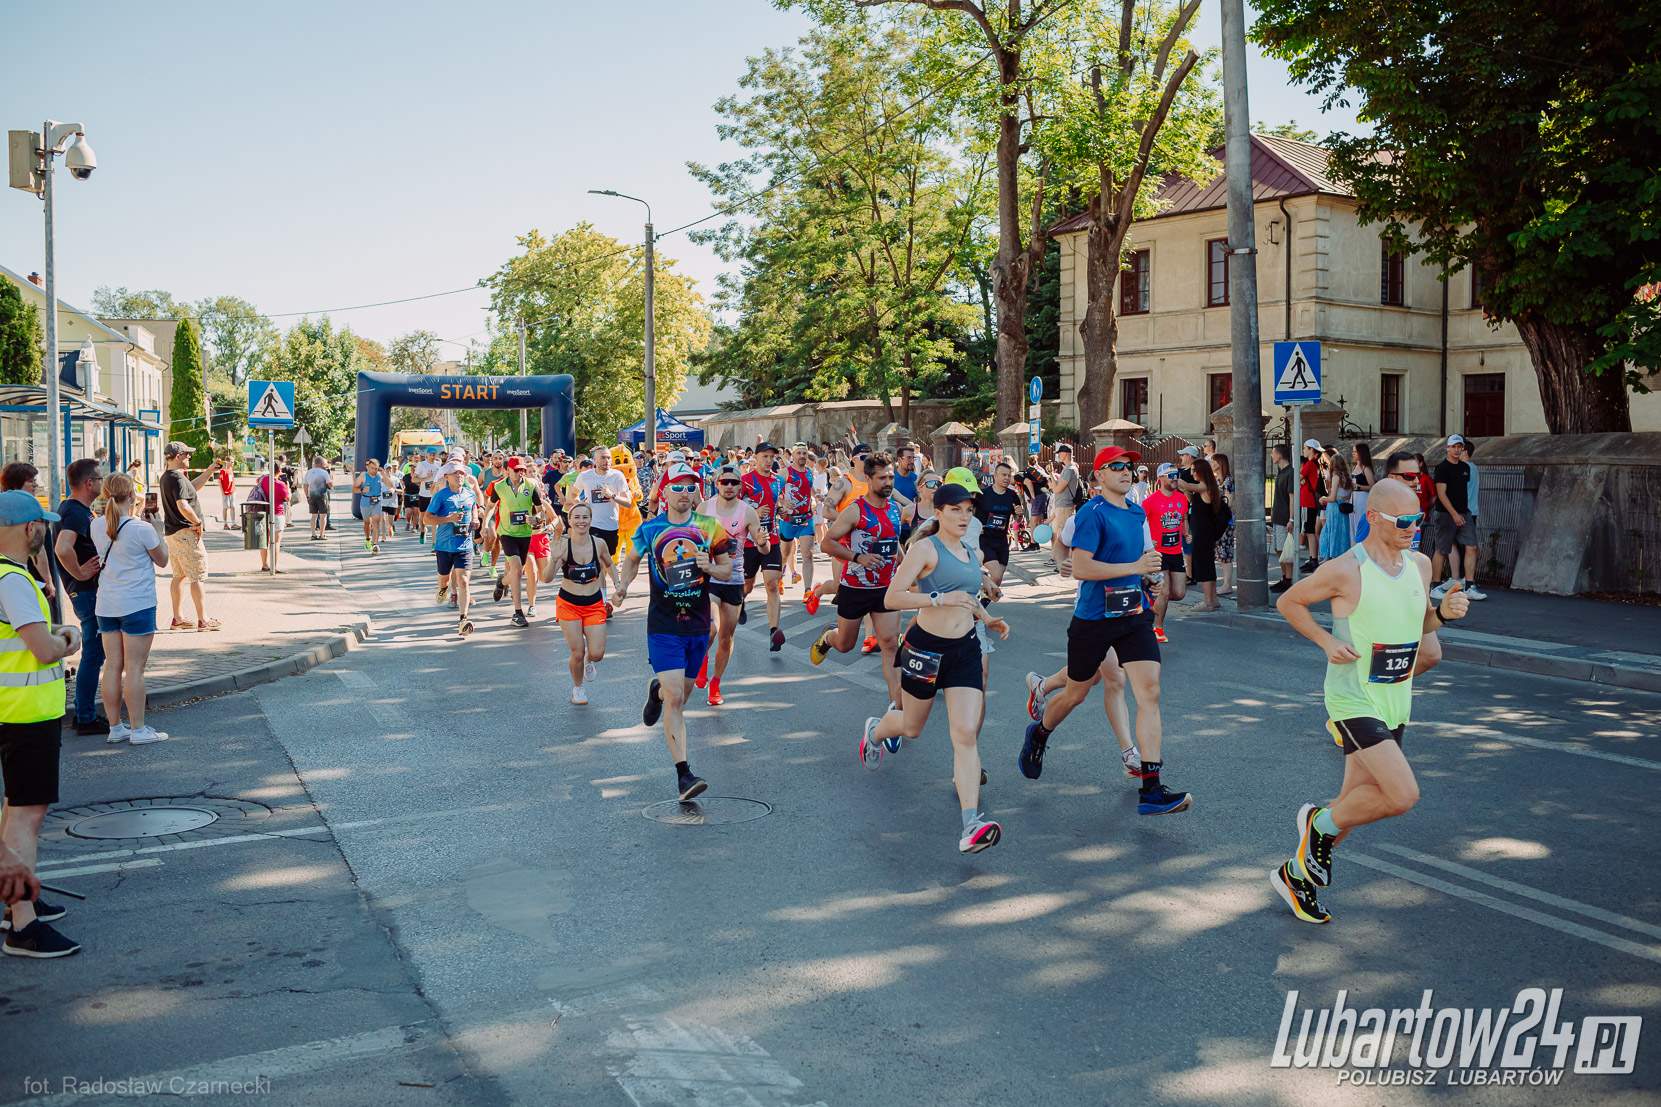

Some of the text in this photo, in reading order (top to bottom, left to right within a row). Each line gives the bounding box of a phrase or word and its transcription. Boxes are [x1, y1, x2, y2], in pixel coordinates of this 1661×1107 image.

[440, 384, 500, 400] START
[881, 545, 891, 553] 14
[678, 569, 692, 580] 75
[1122, 597, 1129, 607] 5
[908, 659, 923, 671] 60
[1385, 657, 1409, 671] 126
